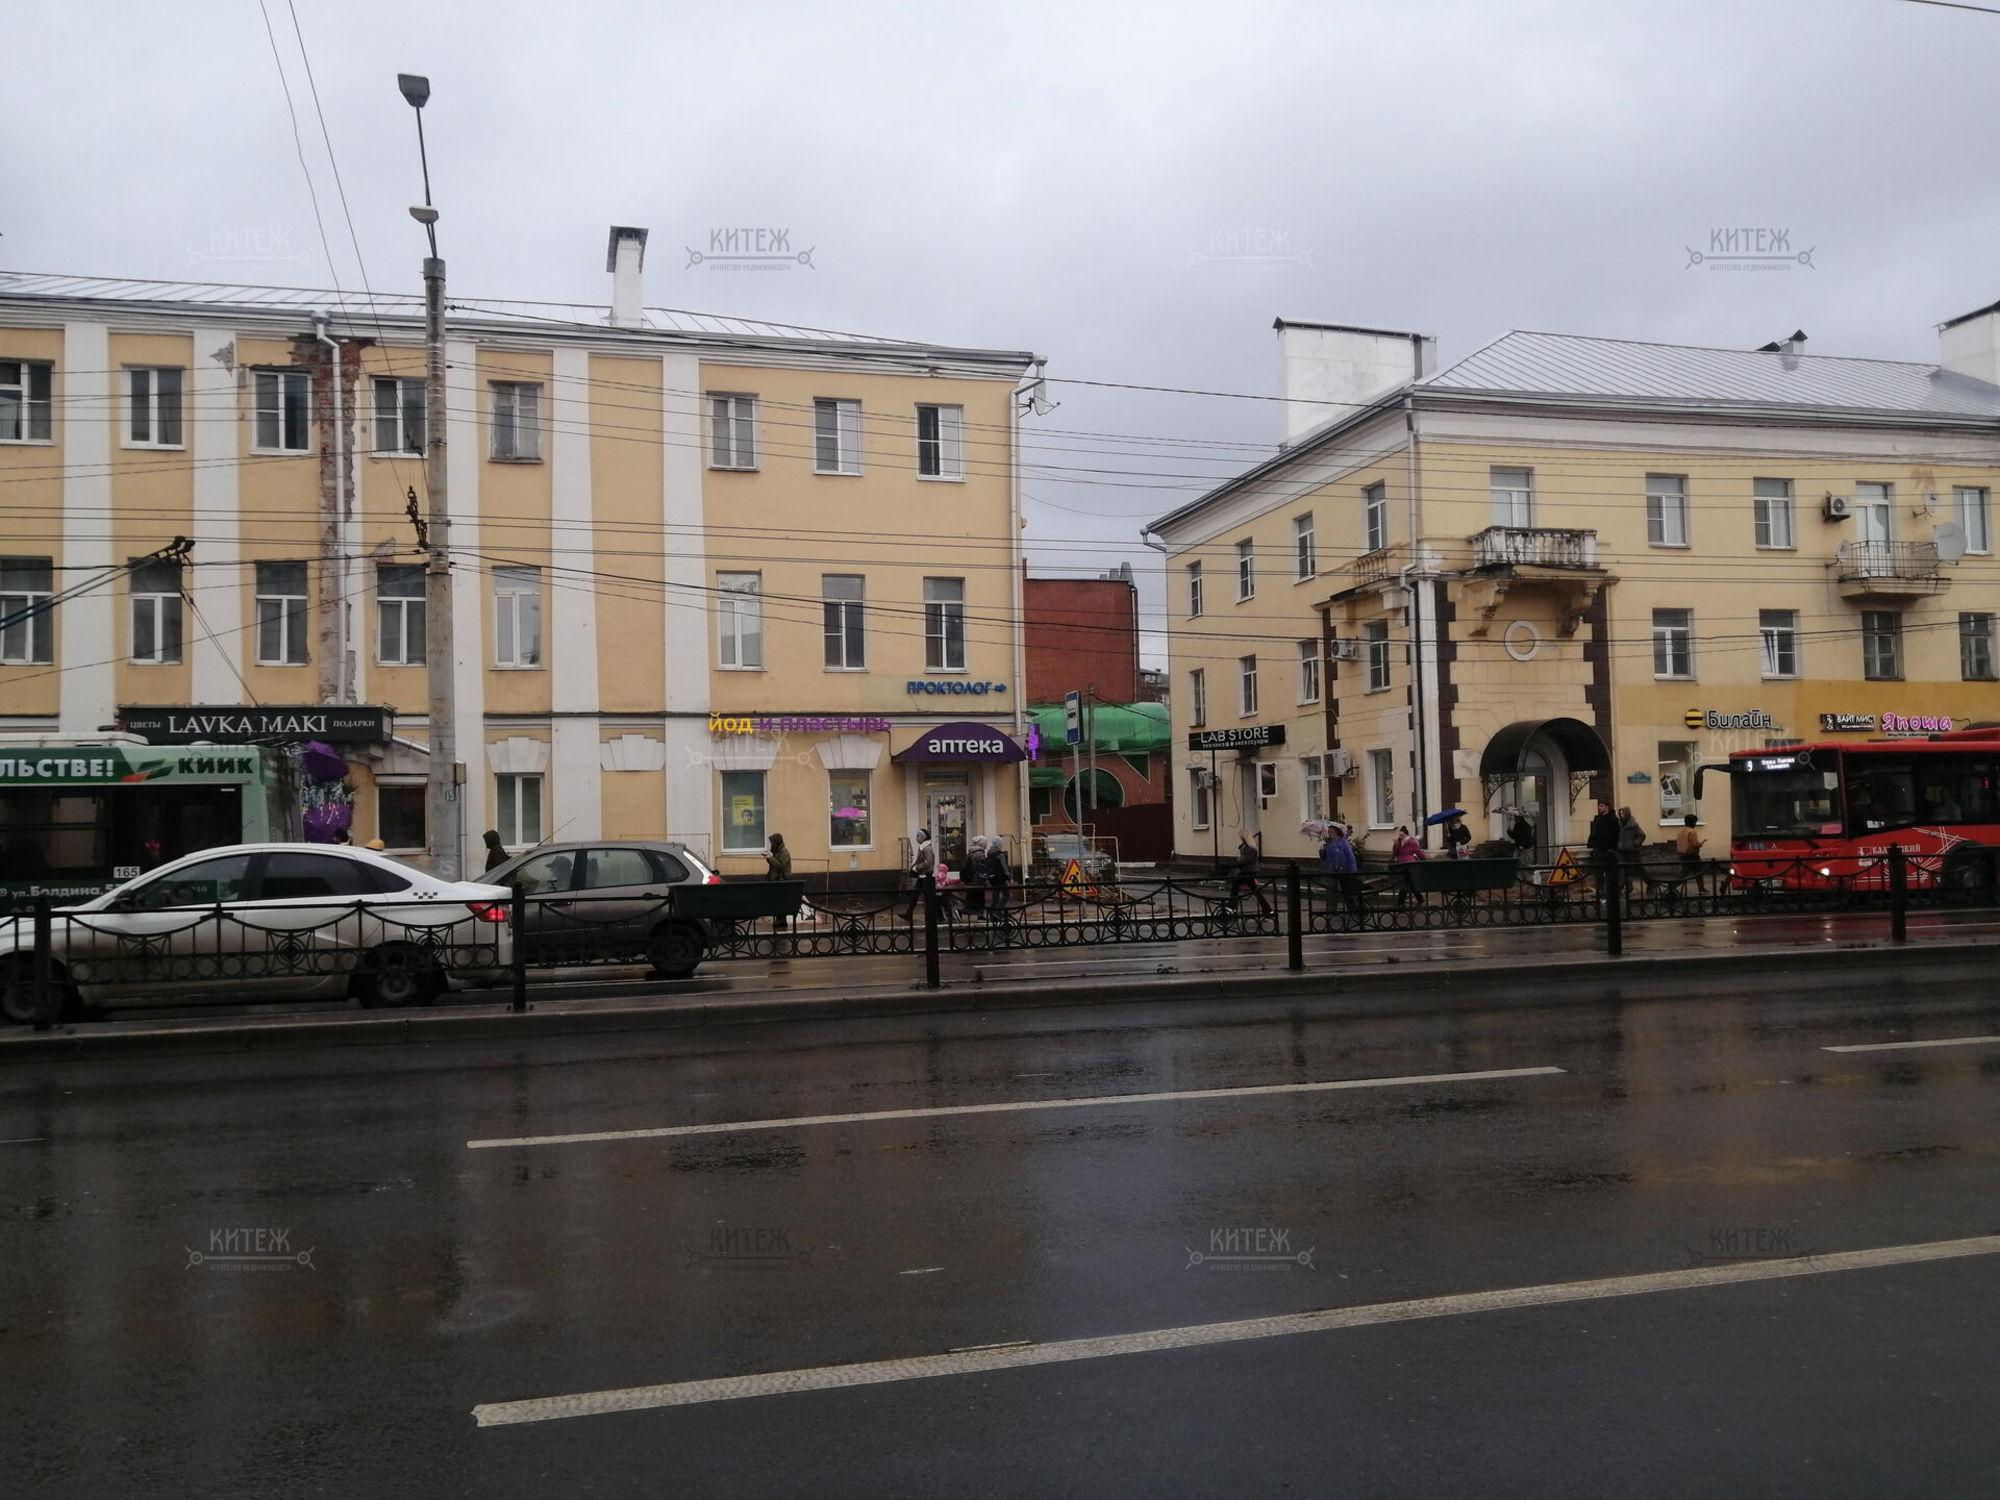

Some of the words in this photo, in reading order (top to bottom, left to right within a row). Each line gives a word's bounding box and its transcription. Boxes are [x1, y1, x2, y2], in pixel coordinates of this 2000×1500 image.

[907, 681, 992, 694] ПРОКТОЛОГ
[130, 721, 161, 729] ЦВЕТЫ
[168, 716, 254, 733] LAVKA
[260, 715, 327, 733] MAKI
[333, 720, 375, 728] ПОДАРКИ
[1708, 709, 1772, 728] Билайн
[1200, 731, 1226, 744] LAB
[1229, 726, 1270, 741] STORE
[928, 739, 1003, 753] аптека
[0, 758, 114, 777] ЛЬСТВЕ!
[178, 758, 253, 774] КИИК
[1747, 760, 1753, 772] 9
[115, 867, 138, 877] 165
